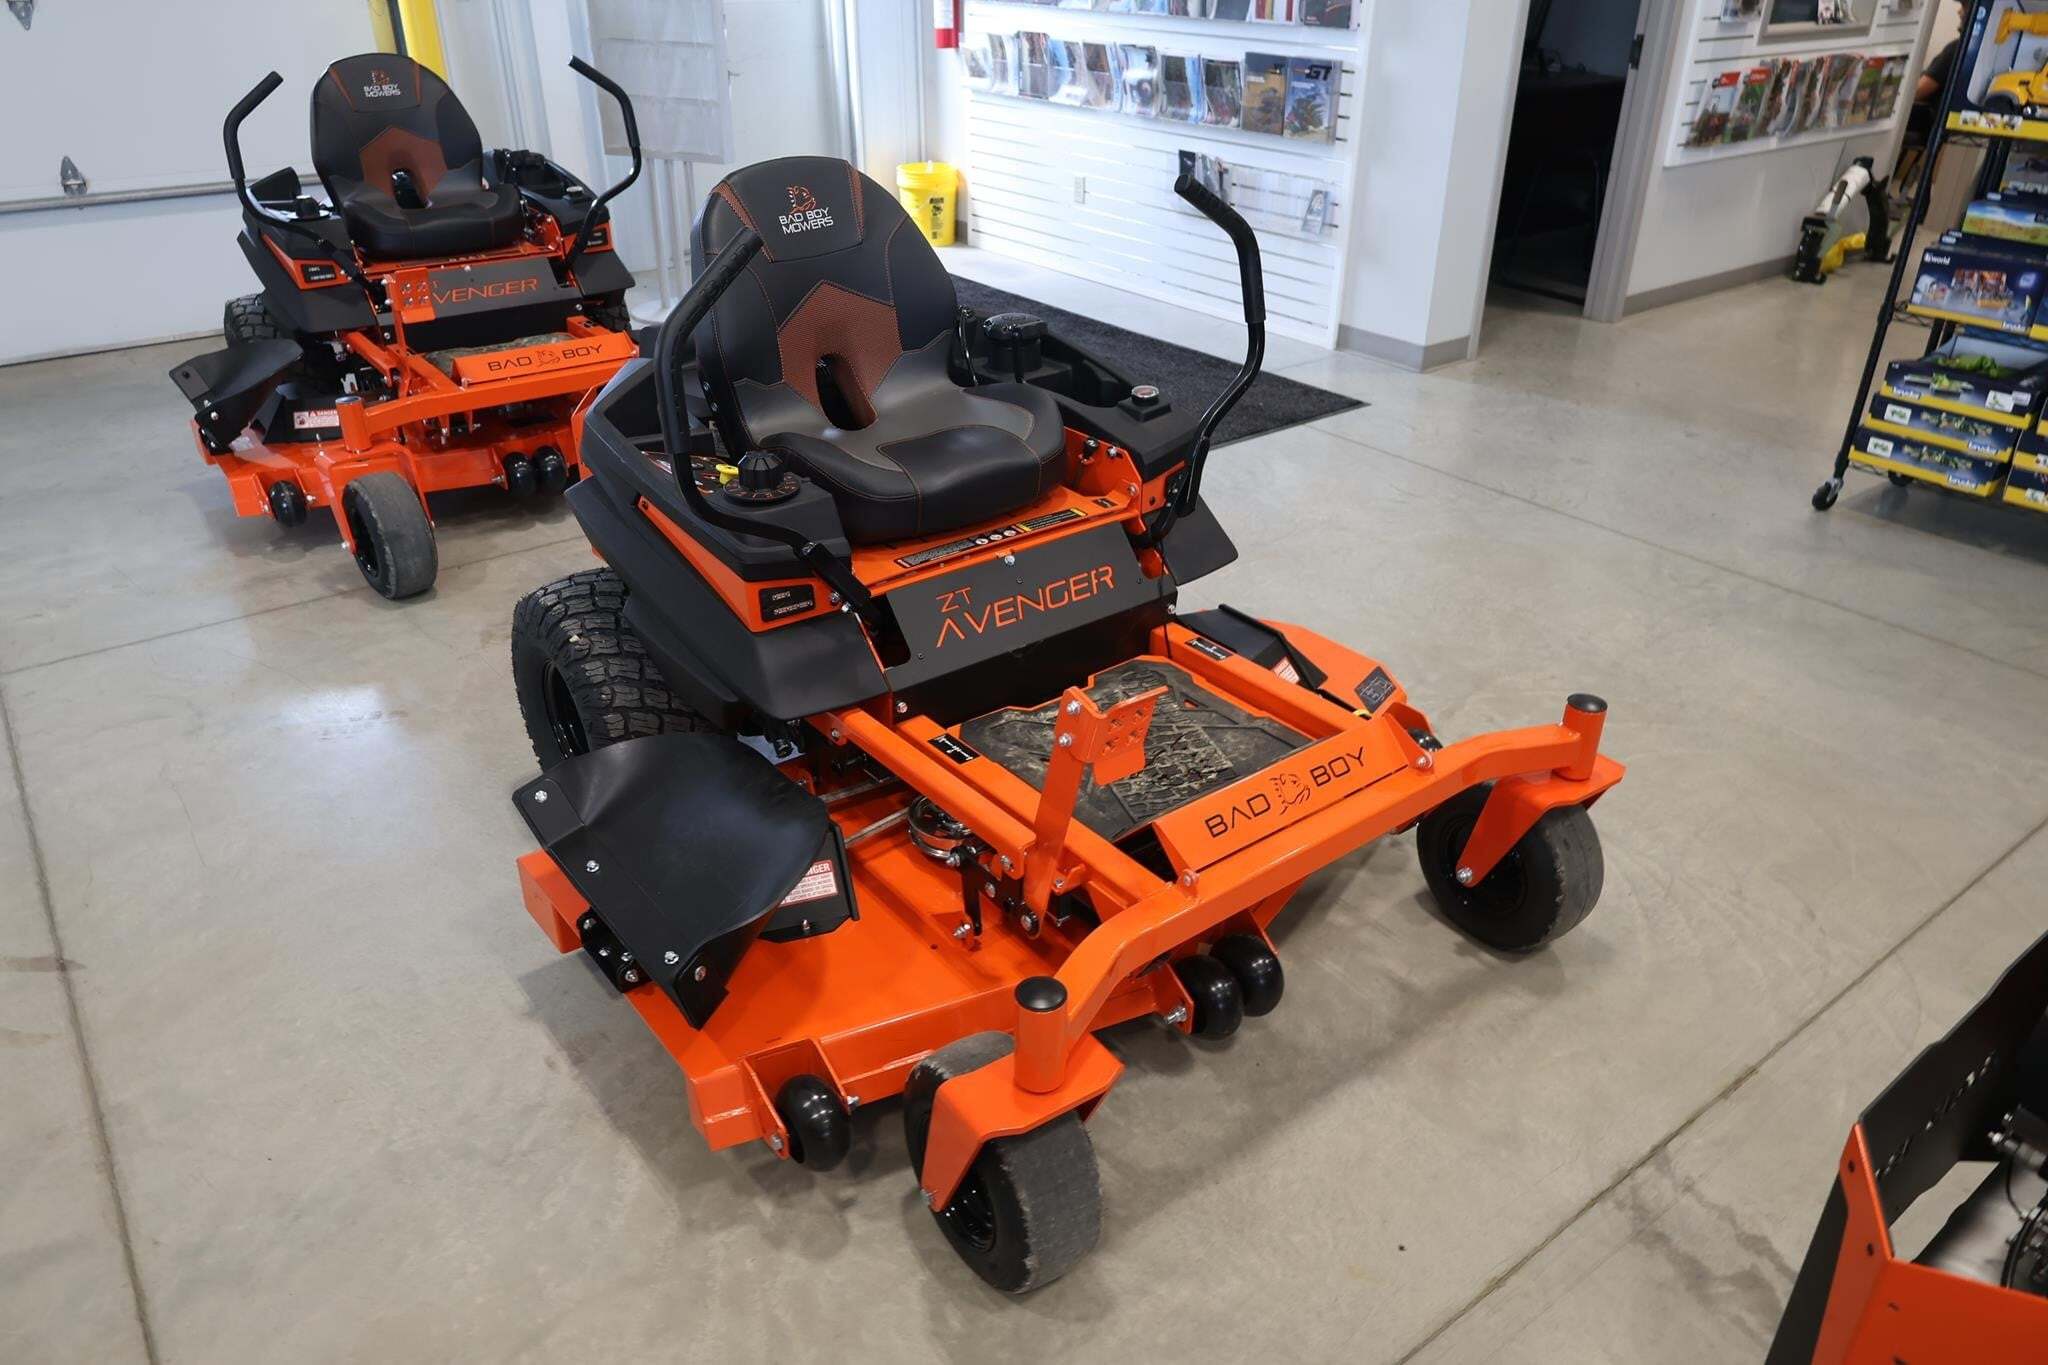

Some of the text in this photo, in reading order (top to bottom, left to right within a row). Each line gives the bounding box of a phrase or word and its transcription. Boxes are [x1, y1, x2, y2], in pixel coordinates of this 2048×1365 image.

[779, 207, 829, 225] BAD BOY
[781, 216, 834, 235] MOWERS
[432, 278, 537, 305] VENGER
[487, 343, 602, 372] BAD BOY
[935, 586, 972, 613] ZT
[936, 564, 1115, 649] AVENGER
[1204, 746, 1366, 838] BAD BOY
